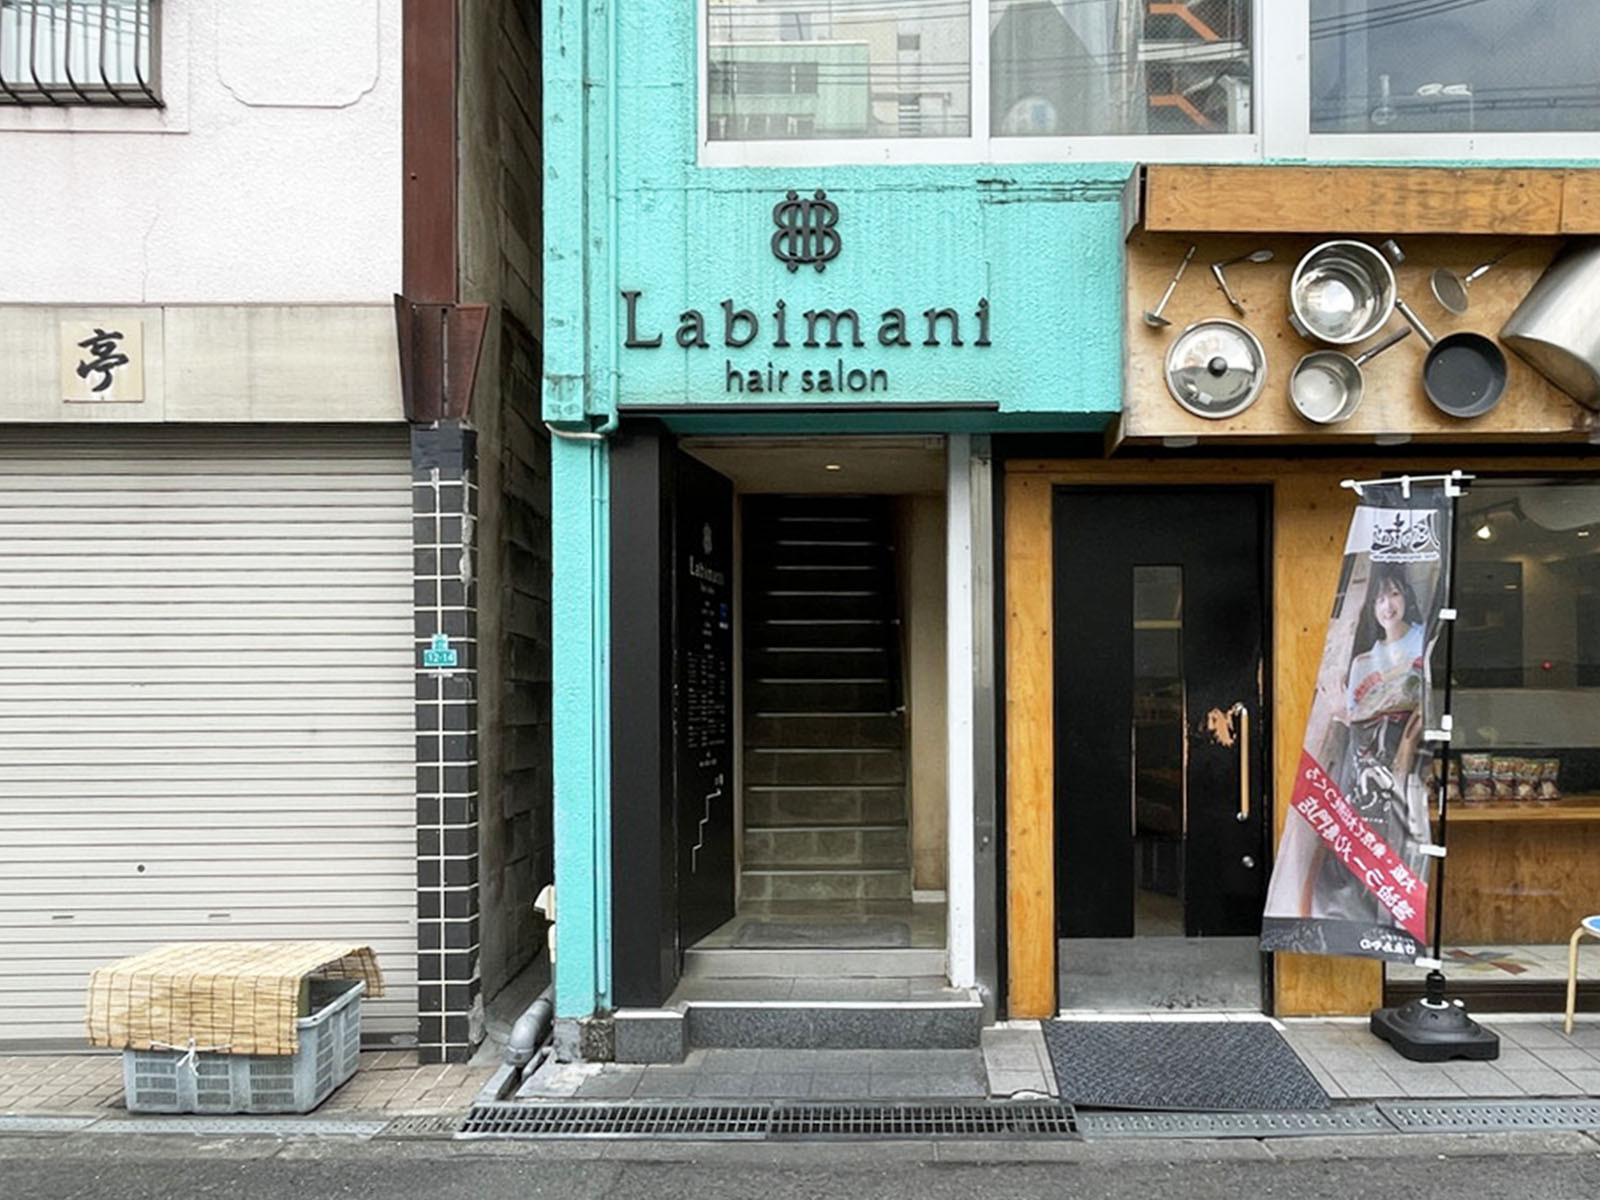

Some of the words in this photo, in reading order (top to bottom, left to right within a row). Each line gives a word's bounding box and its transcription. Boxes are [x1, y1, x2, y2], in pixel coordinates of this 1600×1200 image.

[620, 290, 992, 349] Labimani
[76, 328, 130, 392] 亭
[725, 359, 790, 393] hair
[801, 359, 888, 393] salon
